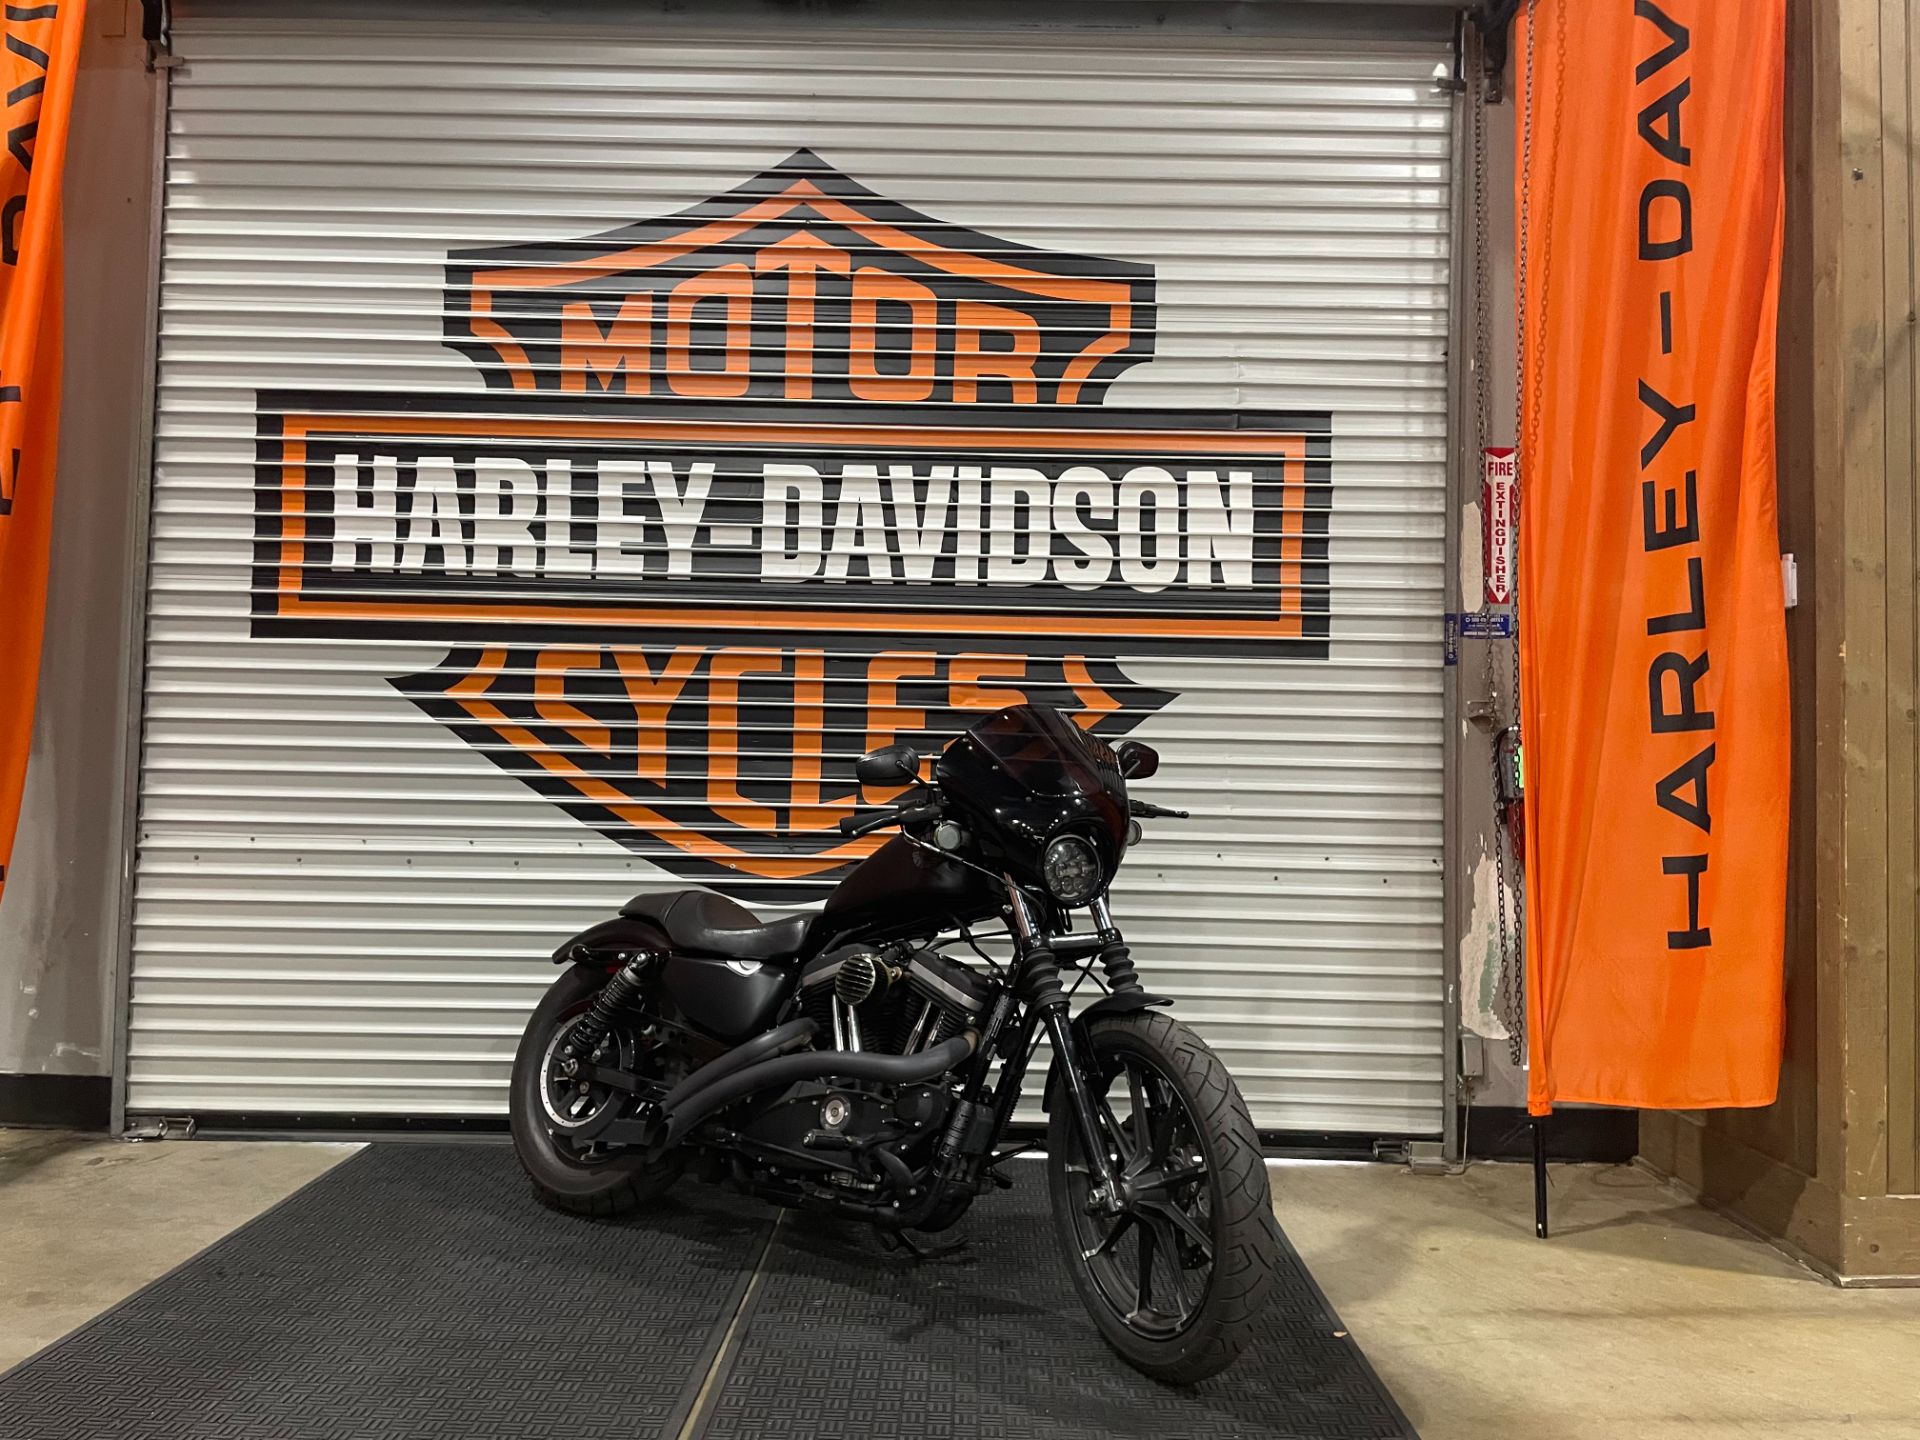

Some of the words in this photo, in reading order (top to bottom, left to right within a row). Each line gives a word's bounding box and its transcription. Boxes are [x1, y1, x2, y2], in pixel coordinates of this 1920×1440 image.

[560, 230, 1041, 404] MOTOR
[331, 454, 1255, 594] HARLEY-DAVIDSON
[1488, 462, 1513, 476] FIRE
[1495, 482, 1505, 593] EXTINGUISHER
